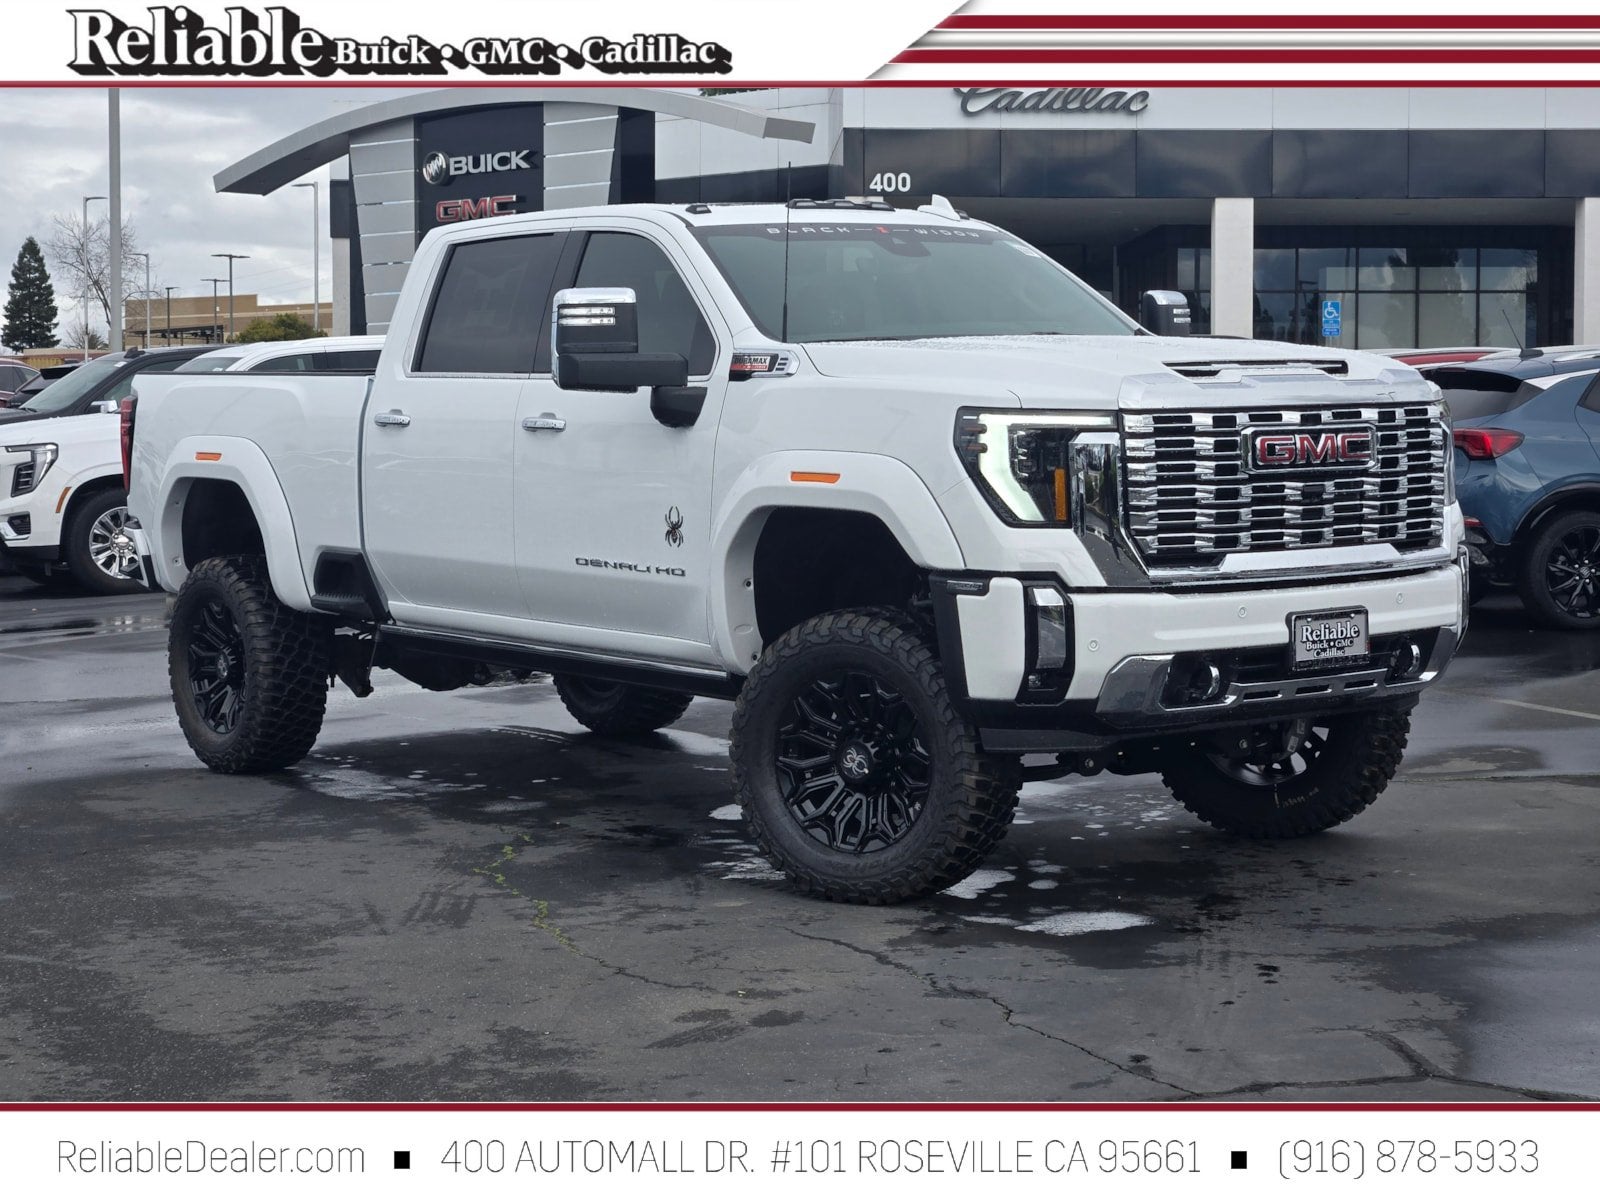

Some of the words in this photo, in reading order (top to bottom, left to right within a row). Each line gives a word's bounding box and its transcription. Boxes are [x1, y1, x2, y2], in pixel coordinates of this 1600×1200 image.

[449, 149, 531, 176] BUICK
[869, 172, 911, 192] 400
[436, 194, 517, 222] GMC
[766, 226, 851, 235] BLACK
[913, 227, 981, 238] WIDOW
[1255, 432, 1372, 465] GMC
[575, 557, 652, 574] DENALI
[655, 566, 686, 577] HD
[1301, 620, 1360, 643] Reliable
[1306, 640, 1330, 651] Buick
[1334, 638, 1355, 648] GMC
[1313, 647, 1346, 658] Cadillac
